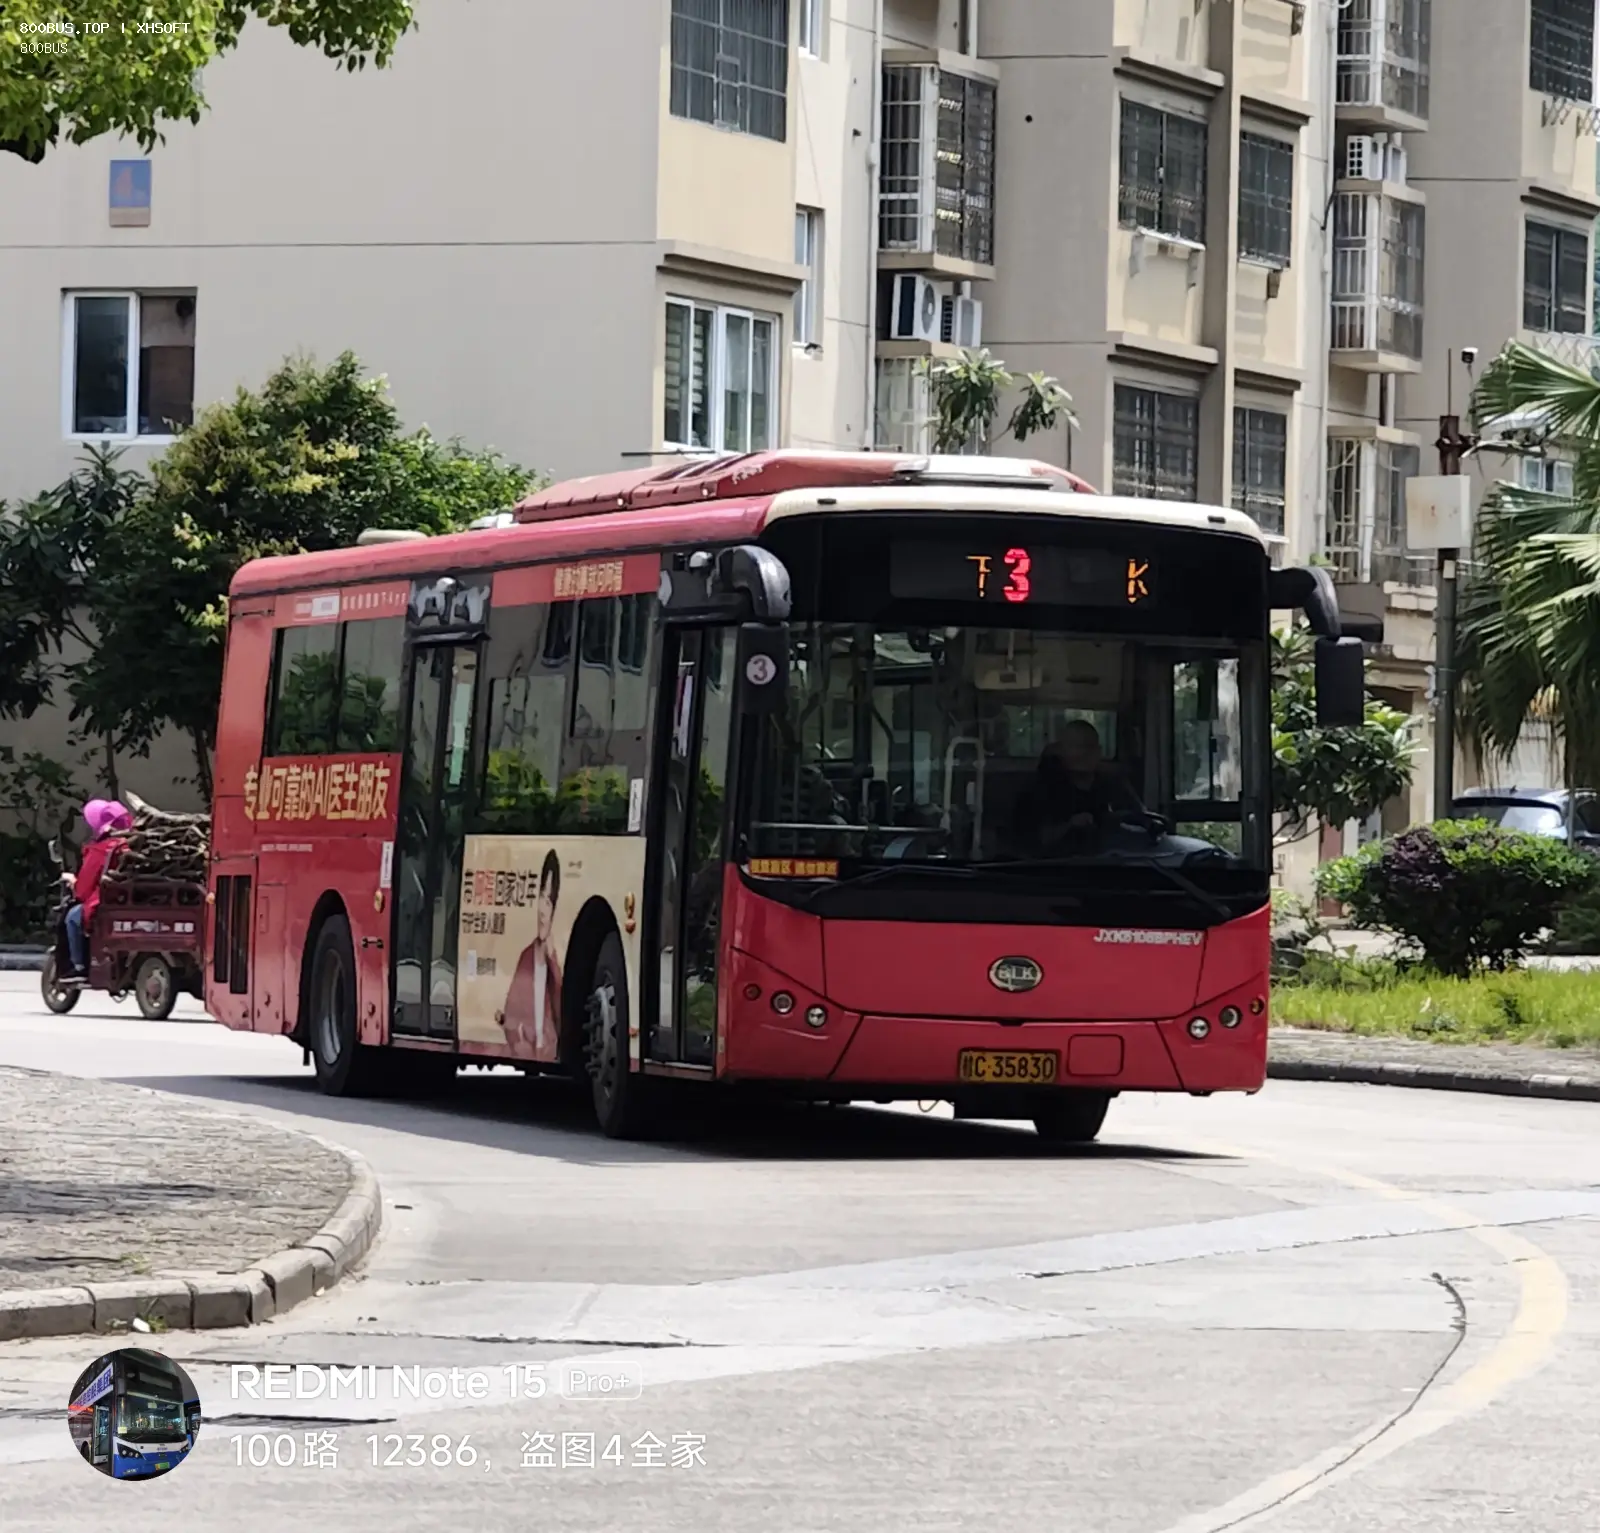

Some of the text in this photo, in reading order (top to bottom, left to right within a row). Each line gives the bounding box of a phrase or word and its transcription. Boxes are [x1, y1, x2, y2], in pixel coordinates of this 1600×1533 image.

[1003, 548, 1031, 602] 3
[244, 760, 391, 821] 专业可靠的AI医生朋友
